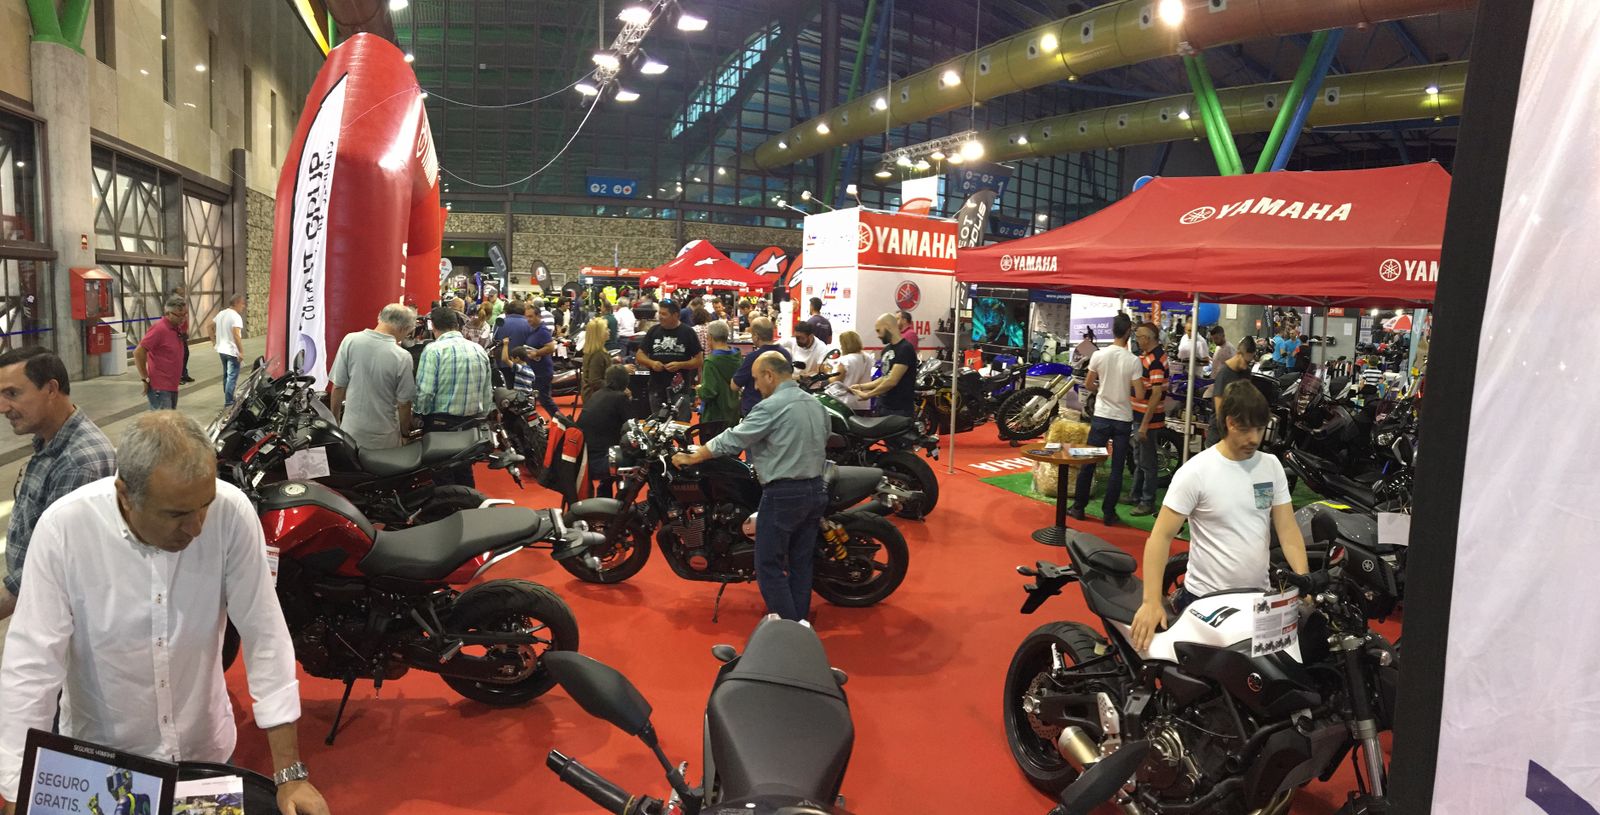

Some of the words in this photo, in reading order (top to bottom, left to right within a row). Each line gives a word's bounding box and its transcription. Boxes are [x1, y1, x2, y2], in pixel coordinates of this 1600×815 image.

[600, 184, 607, 193] 2
[1216, 196, 1353, 222] YAMAHA
[875, 226, 958, 260] YAMAHA
[1013, 256, 1058, 272] YAMAHA
[37, 771, 90, 792] SEGURO
[34, 792, 81, 813] GRATIS.
